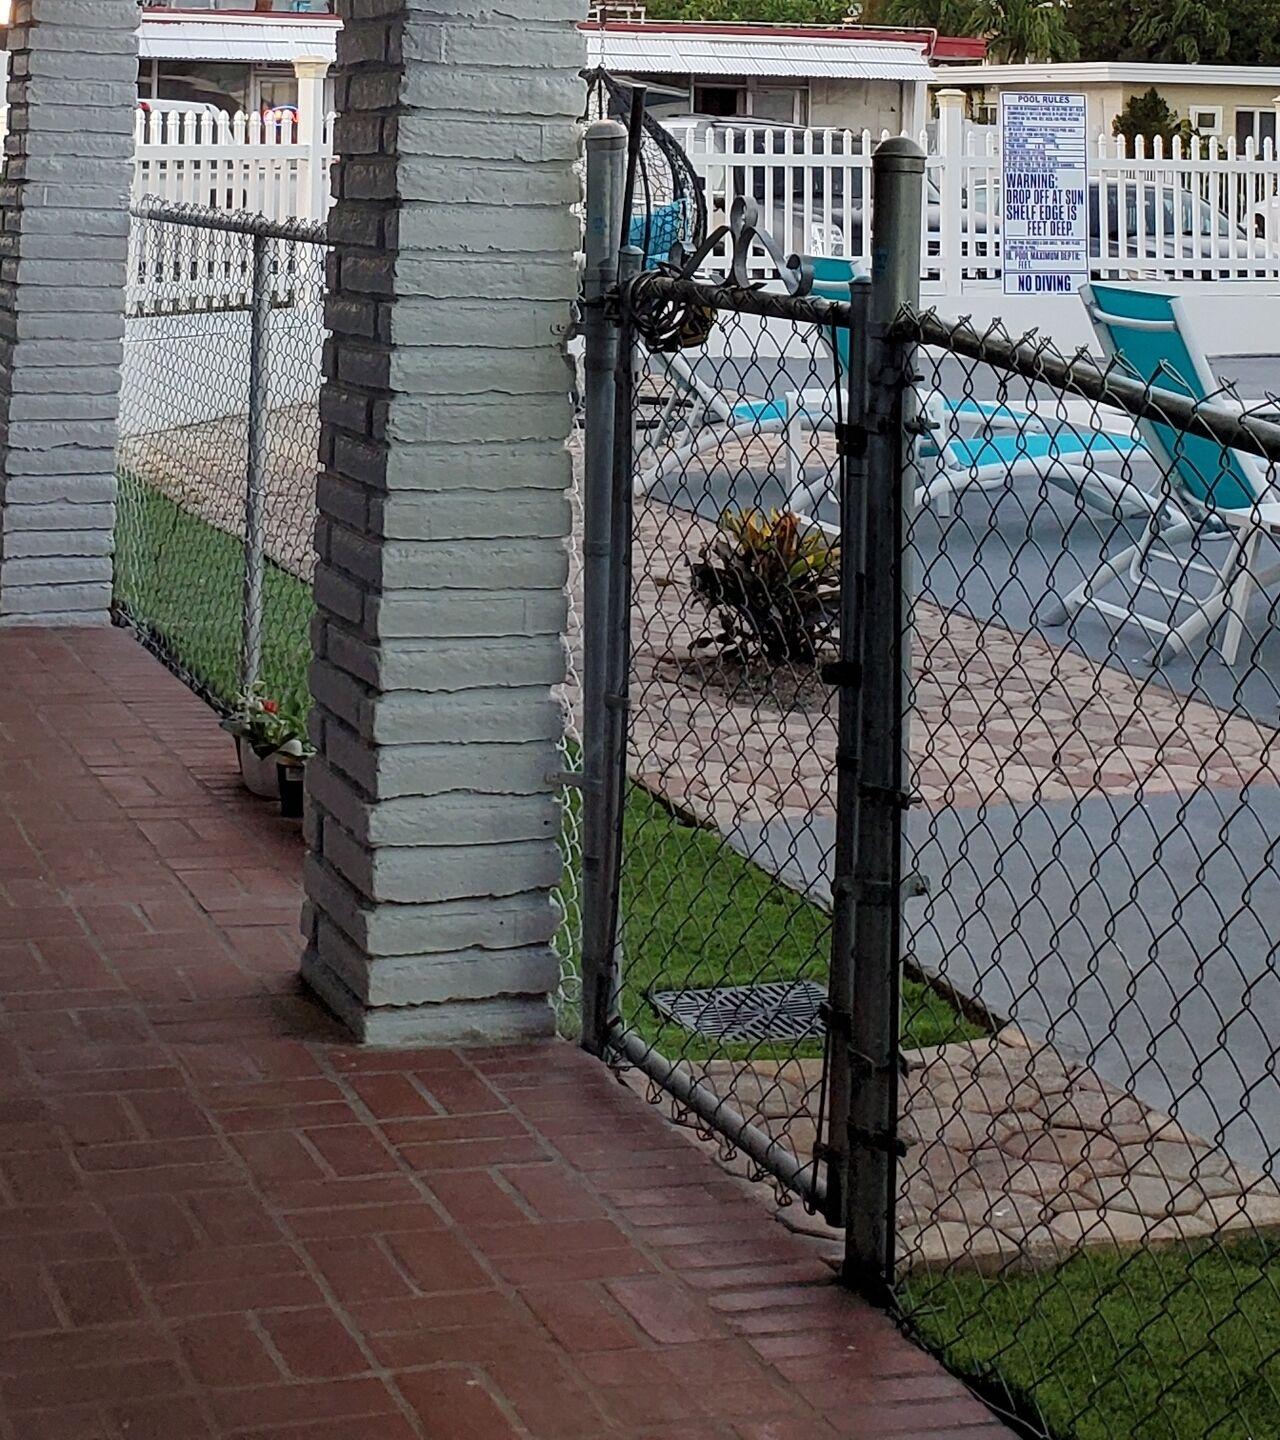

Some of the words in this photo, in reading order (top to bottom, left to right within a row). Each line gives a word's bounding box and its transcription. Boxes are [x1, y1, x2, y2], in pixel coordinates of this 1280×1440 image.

[1018, 95, 1040, 103] POOL
[1042, 96, 1070, 104] RULES
[1006, 173, 1058, 189] WARNING:
[1006, 189, 1031, 205] DROP
[1033, 189, 1050, 205] OFF
[1052, 189, 1063, 205] AT
[1065, 189, 1084, 205] SUN
[1006, 205, 1037, 220] SHELF
[1039, 205, 1064, 220] EDGE
[1067, 205, 1077, 220] IS
[1027, 221, 1048, 236] FEET
[1050, 221, 1074, 236] DEEP.
[1018, 275, 1032, 291] NO
[1035, 275, 1071, 291] DIVING
